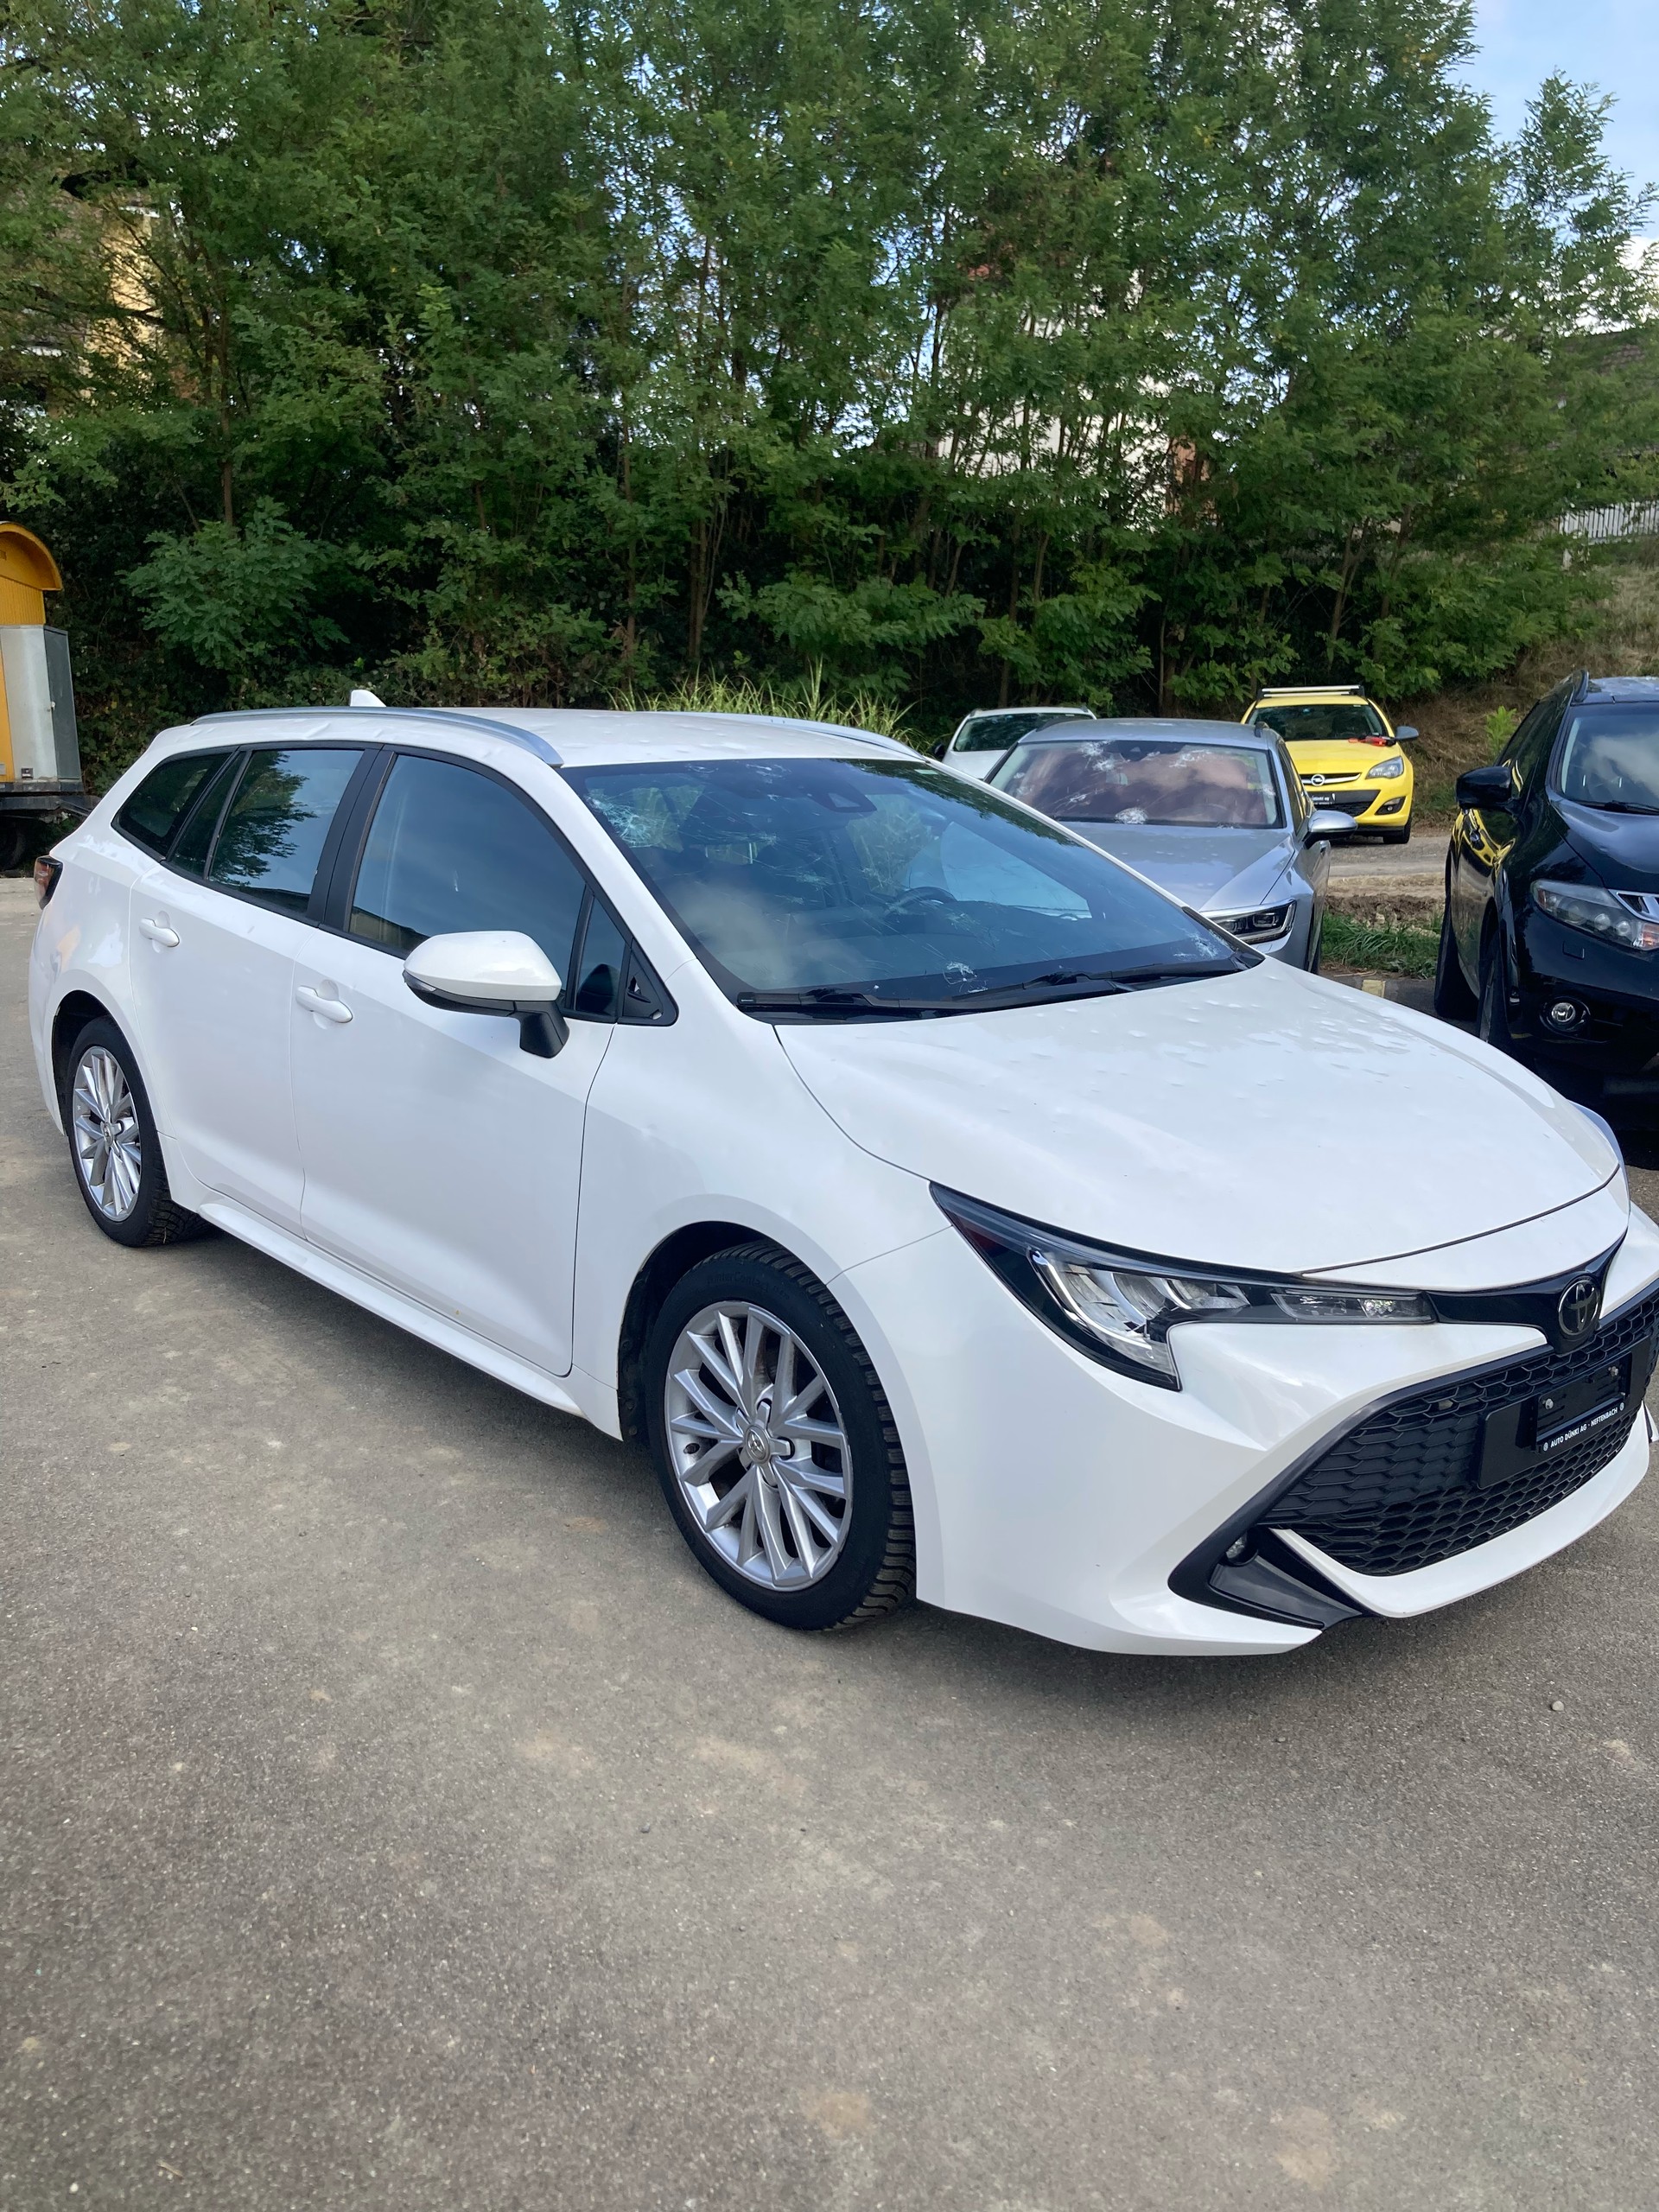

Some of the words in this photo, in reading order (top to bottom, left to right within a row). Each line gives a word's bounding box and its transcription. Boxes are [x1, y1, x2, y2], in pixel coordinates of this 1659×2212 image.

[1550, 1435, 1564, 1447] AUTO
[1580, 1423, 1587, 1433] AG
[1591, 1408, 1618, 1427] NEFTENBACH
